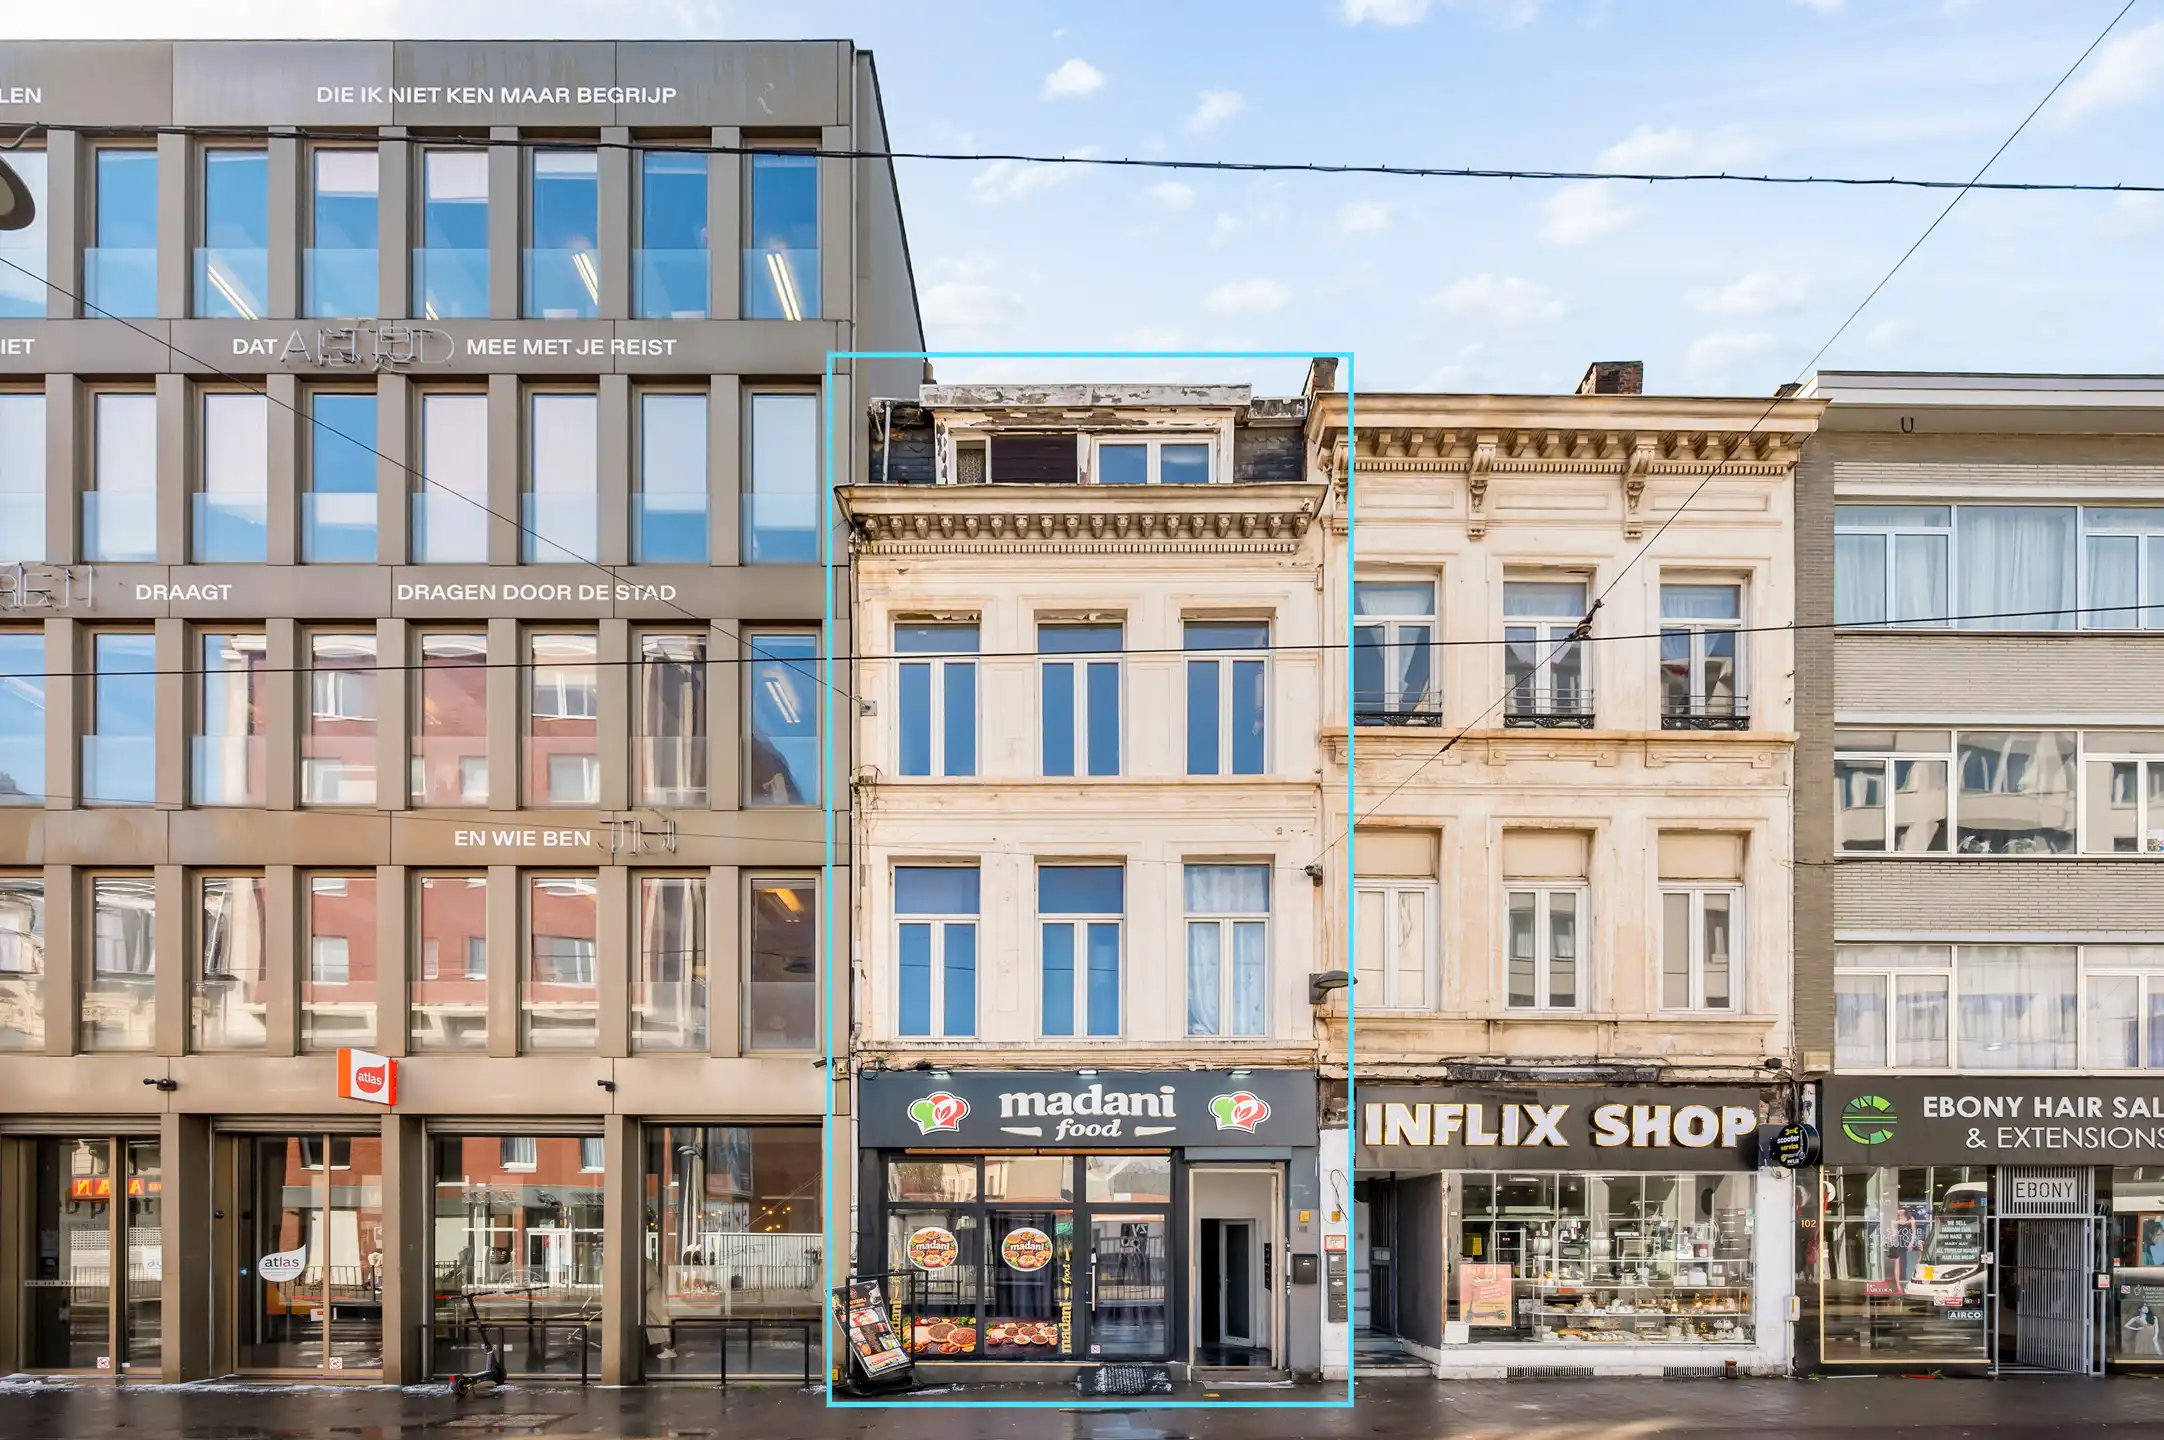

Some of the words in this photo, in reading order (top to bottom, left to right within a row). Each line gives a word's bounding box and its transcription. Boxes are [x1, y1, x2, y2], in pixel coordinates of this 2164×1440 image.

[317, 86, 354, 103] DIE
[361, 86, 384, 103] IK
[388, 87, 442, 104] NIET
[446, 87, 494, 104] KEN
[501, 87, 570, 104] MAAR
[577, 86, 677, 104] BEGRIJP
[1, 338, 36, 355] IET
[233, 338, 278, 355] DAT
[467, 338, 516, 355] MEE
[523, 338, 572, 355] MET
[576, 338, 604, 355] JE
[611, 338, 677, 355] REIST
[135, 584, 233, 601] DRAAGT
[397, 584, 496, 601] DRAGEN
[503, 584, 571, 601] DOOR
[579, 584, 609, 601] DE
[615, 584, 676, 601] STAD
[455, 830, 486, 846] EN
[492, 830, 536, 846] WIE
[543, 830, 591, 846] BEN
[358, 1072, 382, 1086] atlas
[998, 1083, 1177, 1117] madani
[1923, 1096, 2024, 1118] EBONY
[2034, 1096, 2103, 1118] HAIR
[2112, 1096, 2164, 1119] SAL
[1055, 1118, 1122, 1142] food
[1364, 1102, 1570, 1147] INFLIX
[1594, 1103, 1757, 1147] SHOP
[1777, 1135, 1799, 1145] scooter
[1965, 1127, 1988, 1149] &
[1780, 1143, 1799, 1151] service
[2016, 1182, 2073, 1198] EBONY
[1801, 1219, 1816, 1228] 102
[915, 1240, 950, 1250] madani
[1010, 1240, 1045, 1251] madani
[264, 1257, 299, 1268] atlas
[1063, 1264, 1072, 1284] food
[1950, 1311, 1981, 1319] AIRCO
[1059, 1302, 1072, 1354] madani
